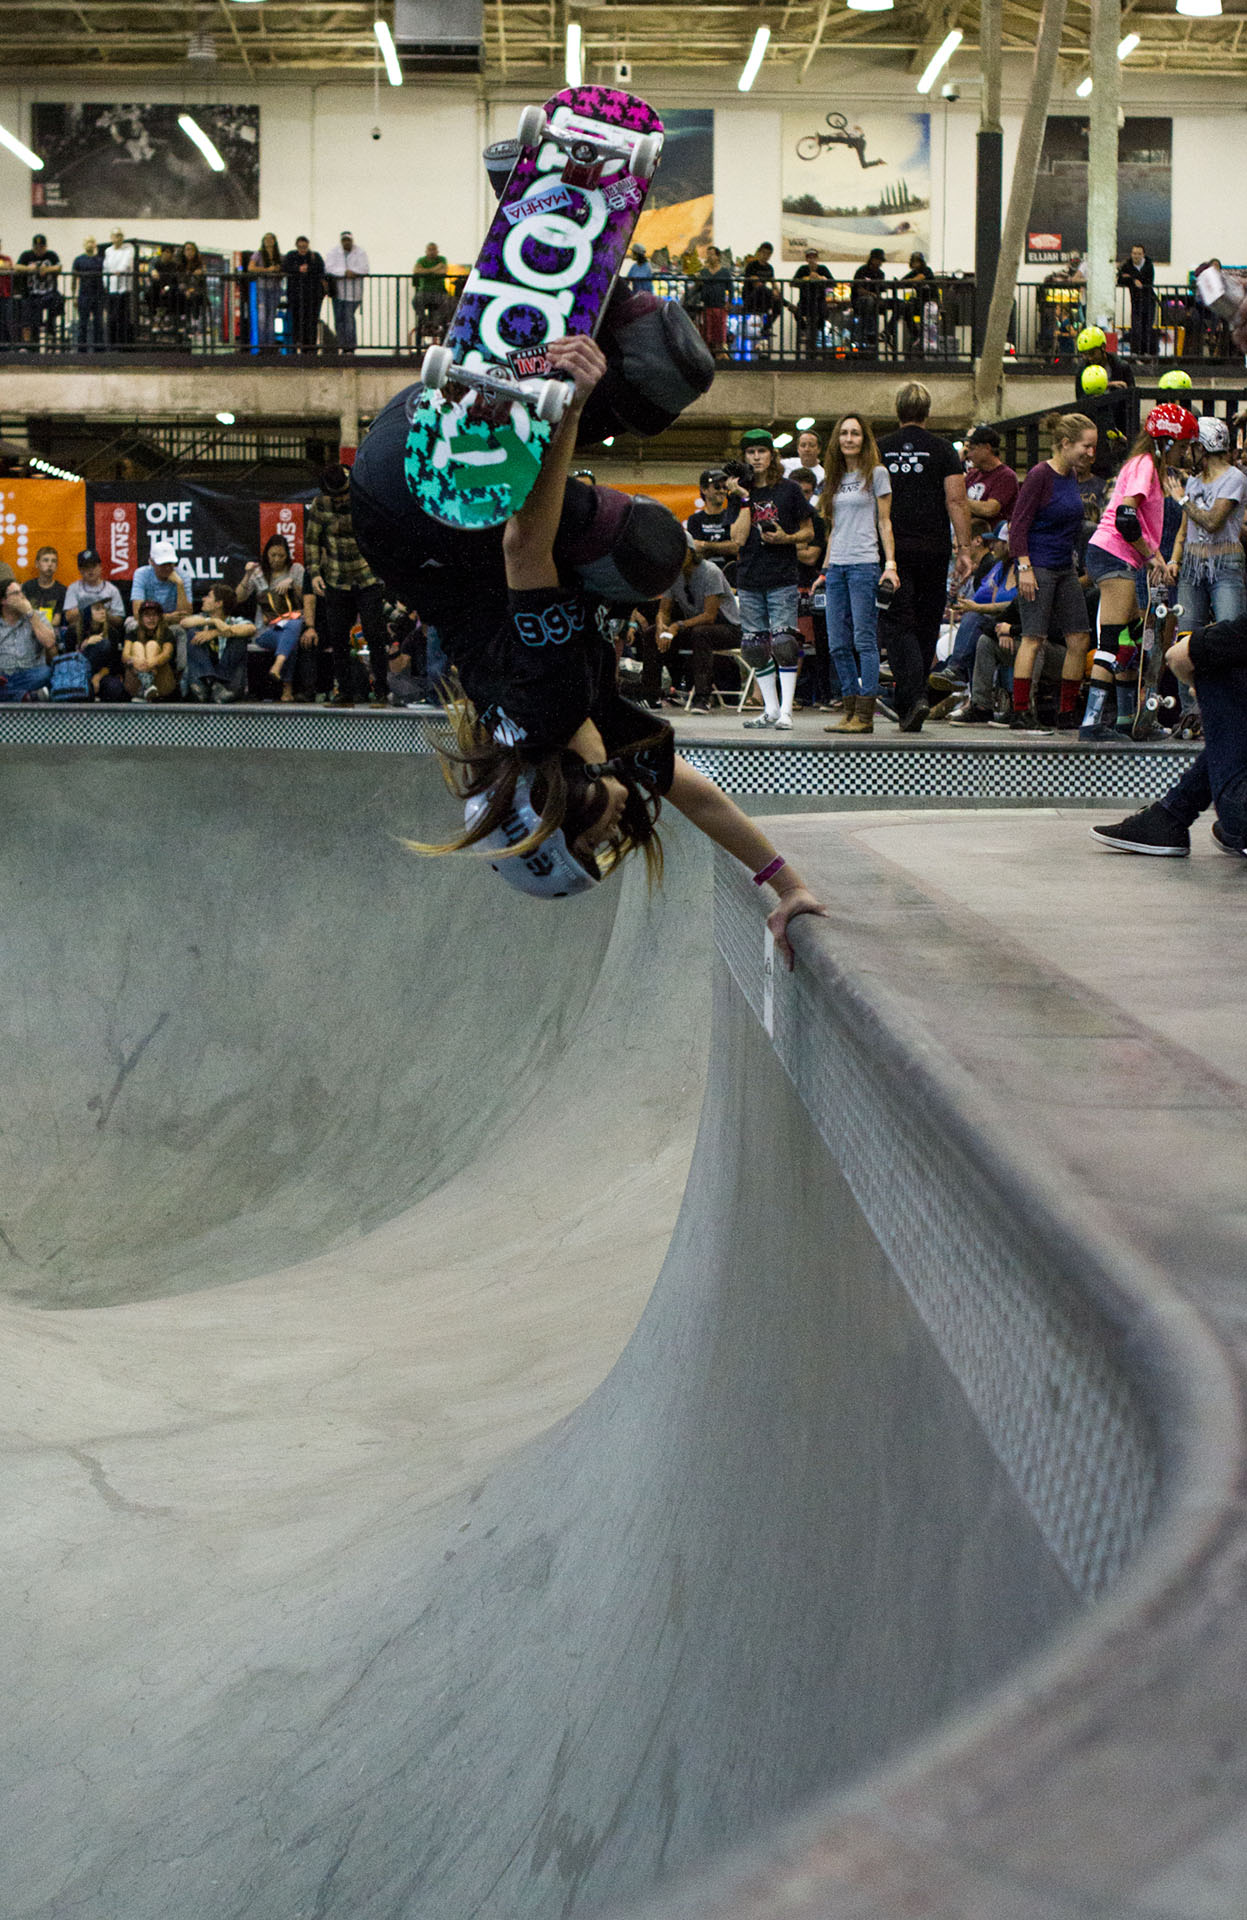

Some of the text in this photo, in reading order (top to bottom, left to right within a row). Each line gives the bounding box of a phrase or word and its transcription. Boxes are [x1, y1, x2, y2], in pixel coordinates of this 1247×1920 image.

[508, 190, 570, 221] MAHFIA
[138, 501, 193, 524] "OFF
[110, 521, 131, 575] VANS
[147, 529, 194, 551] THE
[178, 556, 230, 579] ALL"
